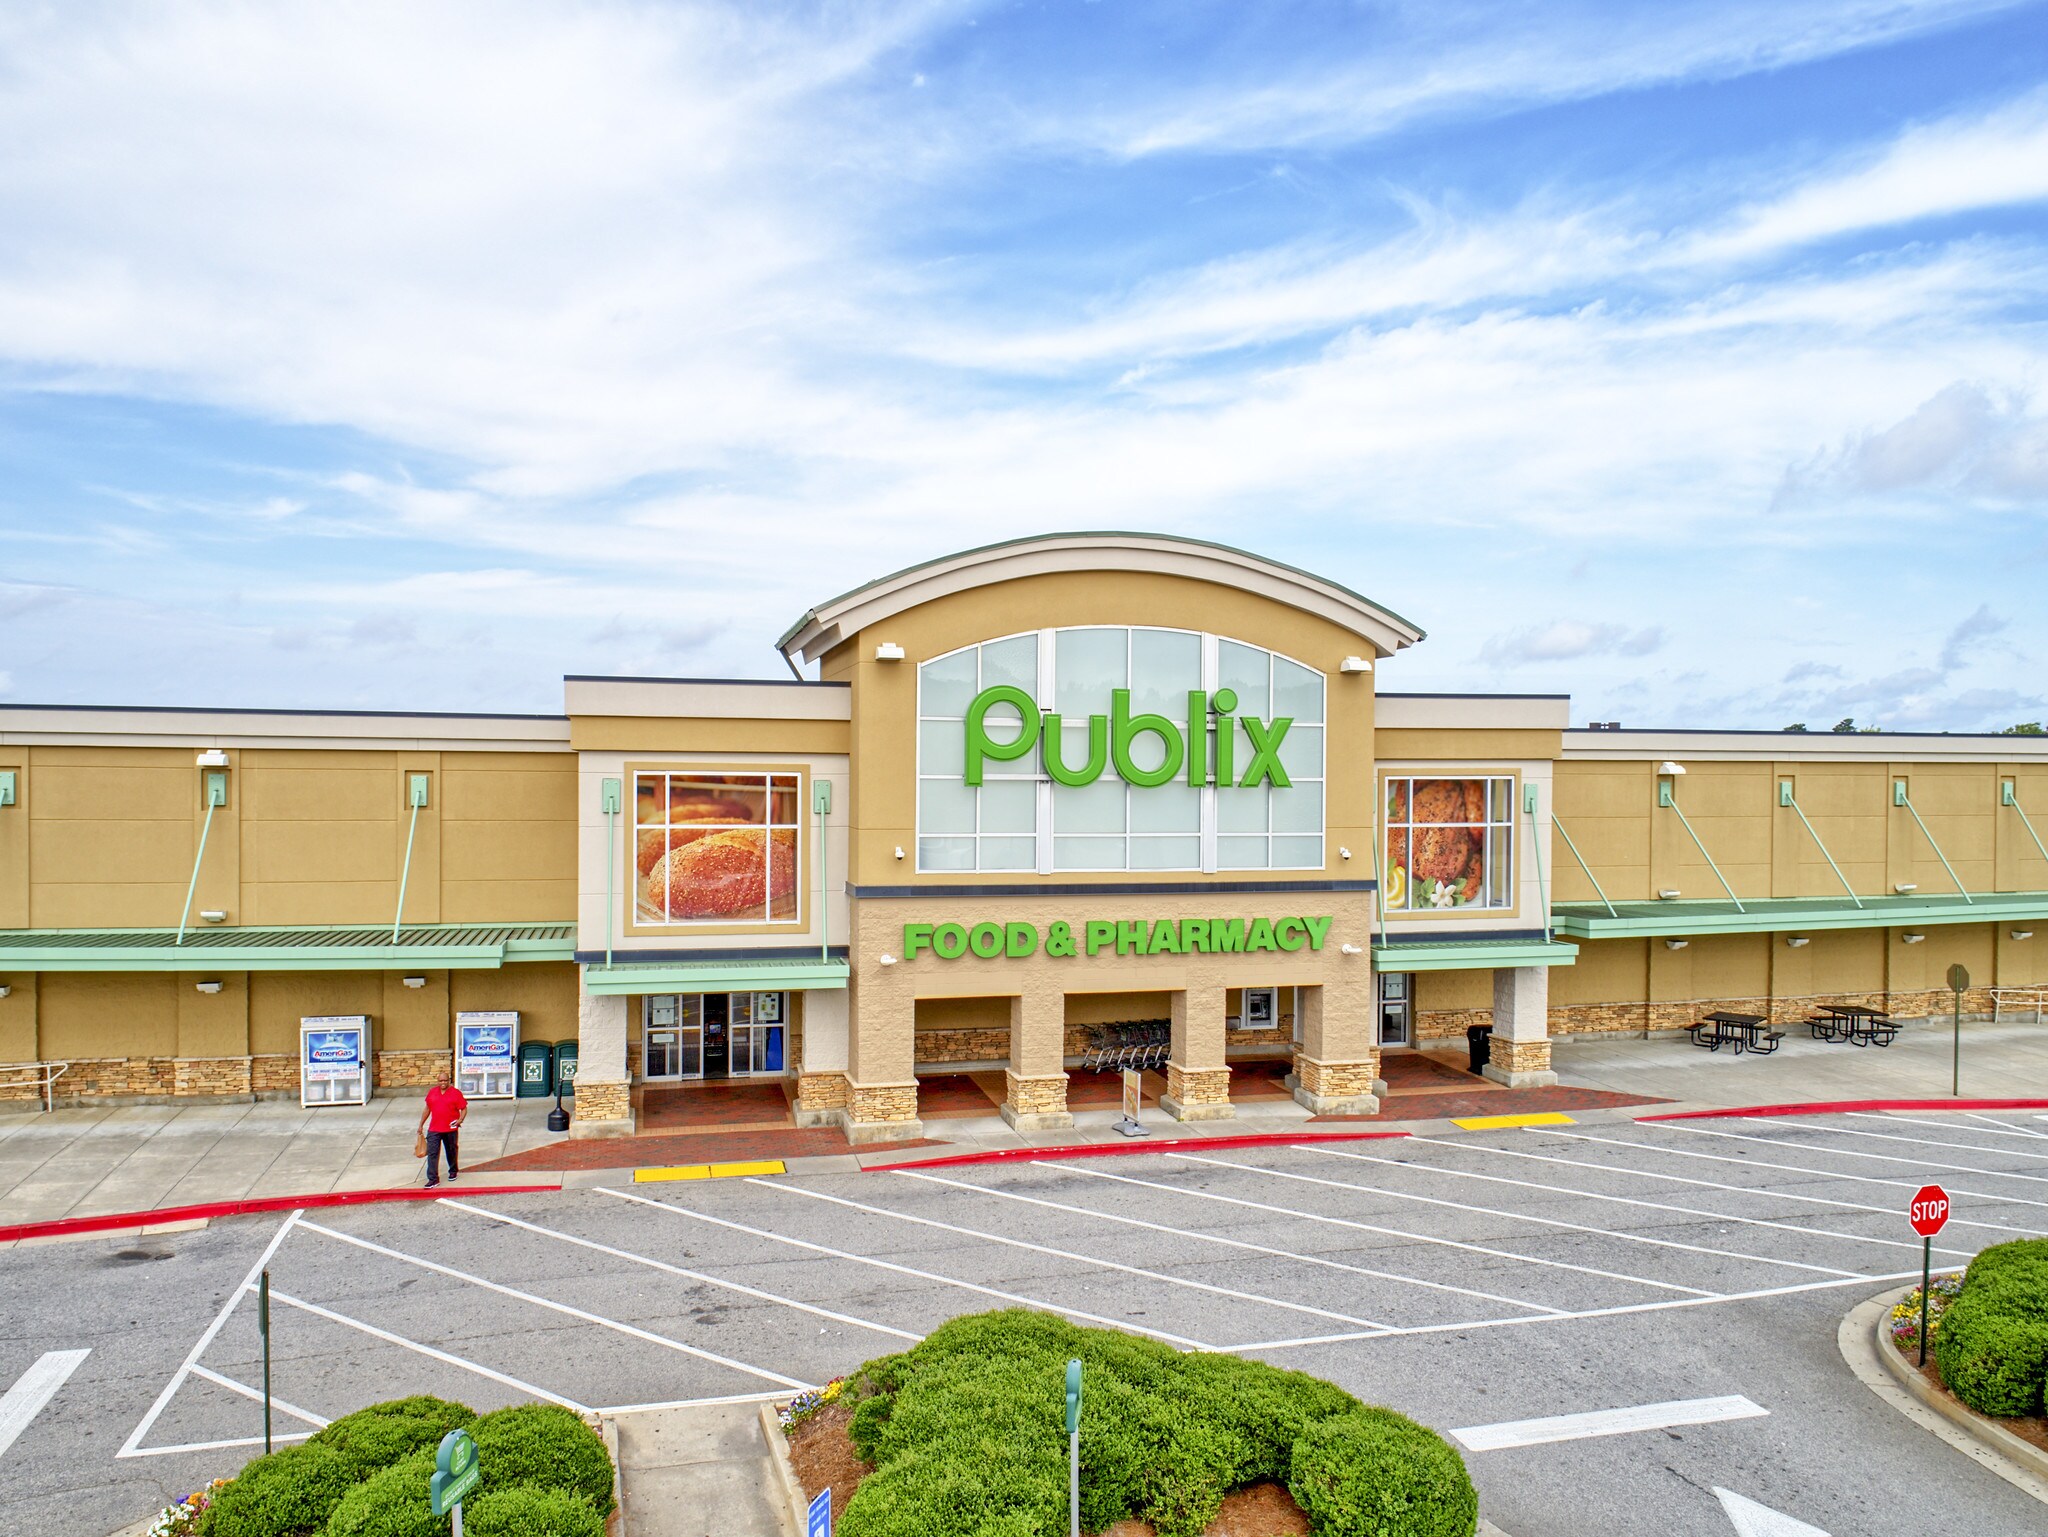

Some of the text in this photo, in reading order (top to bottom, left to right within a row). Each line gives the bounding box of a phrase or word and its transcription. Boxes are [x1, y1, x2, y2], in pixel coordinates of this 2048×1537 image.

[965, 685, 1293, 787] Publix
[903, 917, 1333, 960] FOOD & PHARMACY
[314, 1049, 353, 1058] AmeriGas
[468, 1043, 505, 1051] AmeriGas
[1912, 1200, 1947, 1222] STOP
